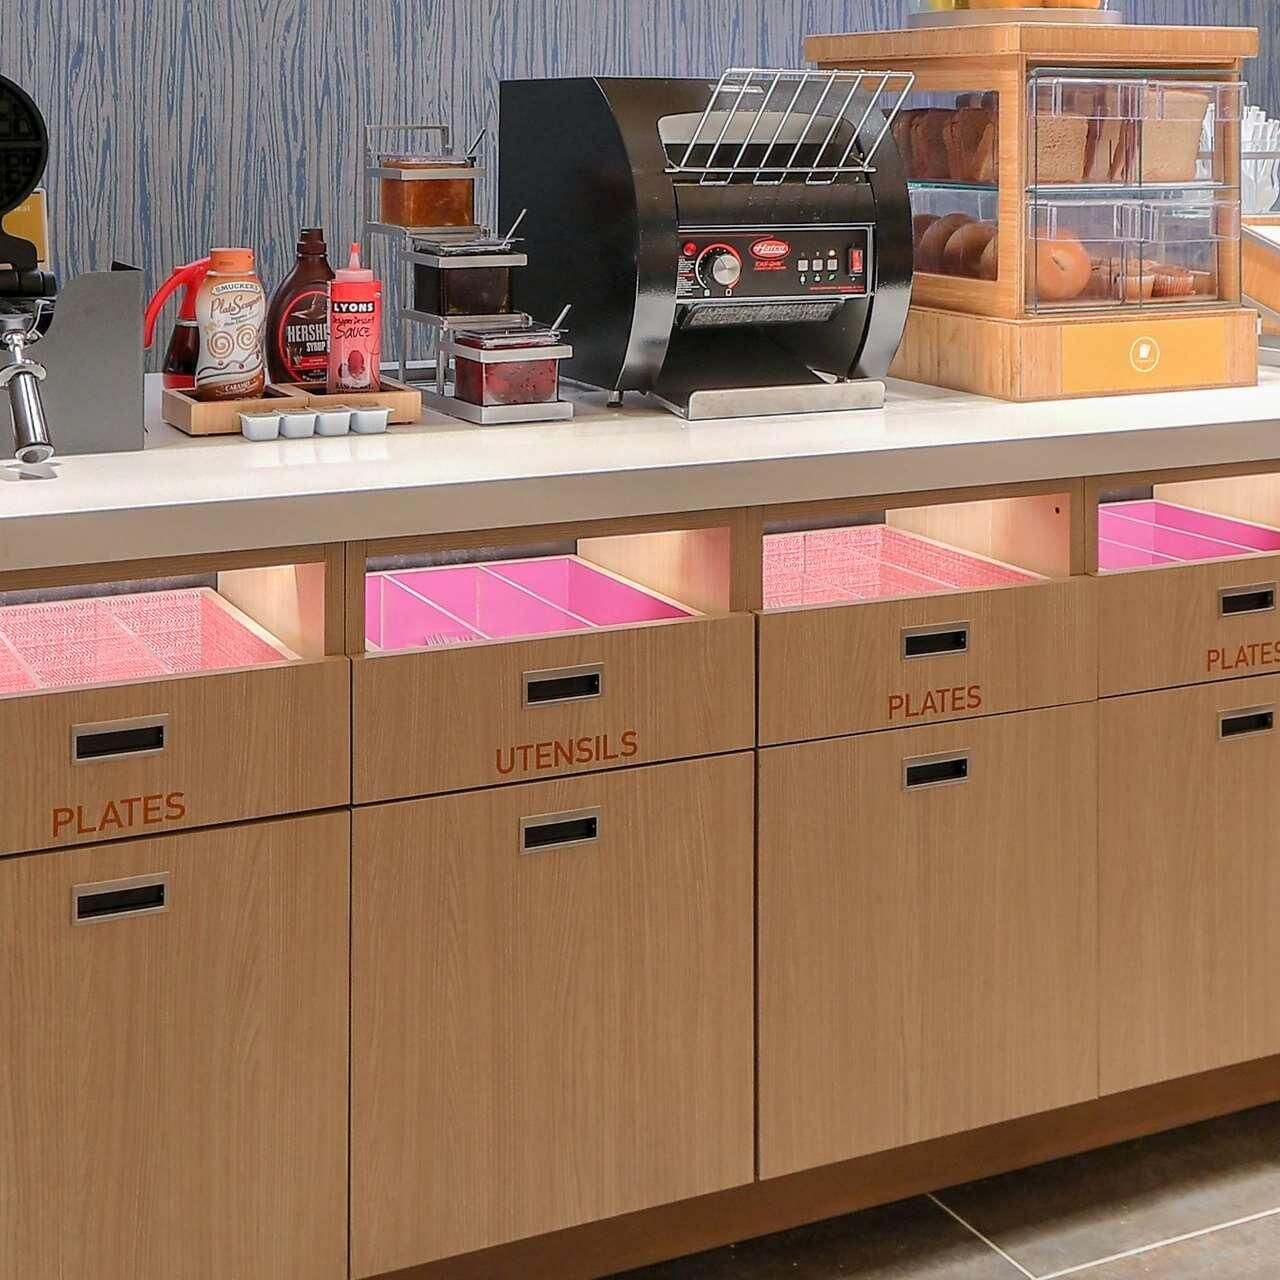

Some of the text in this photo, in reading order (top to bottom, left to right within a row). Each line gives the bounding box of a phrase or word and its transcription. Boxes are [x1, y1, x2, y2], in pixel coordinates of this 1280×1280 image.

[333, 303, 374, 312] LYONS
[287, 323, 329, 343] HERSHE
[306, 341, 326, 352] SYRUP
[888, 685, 982, 720] PLATES
[495, 730, 638, 775] UTENSILS
[52, 791, 186, 838] PLATES
